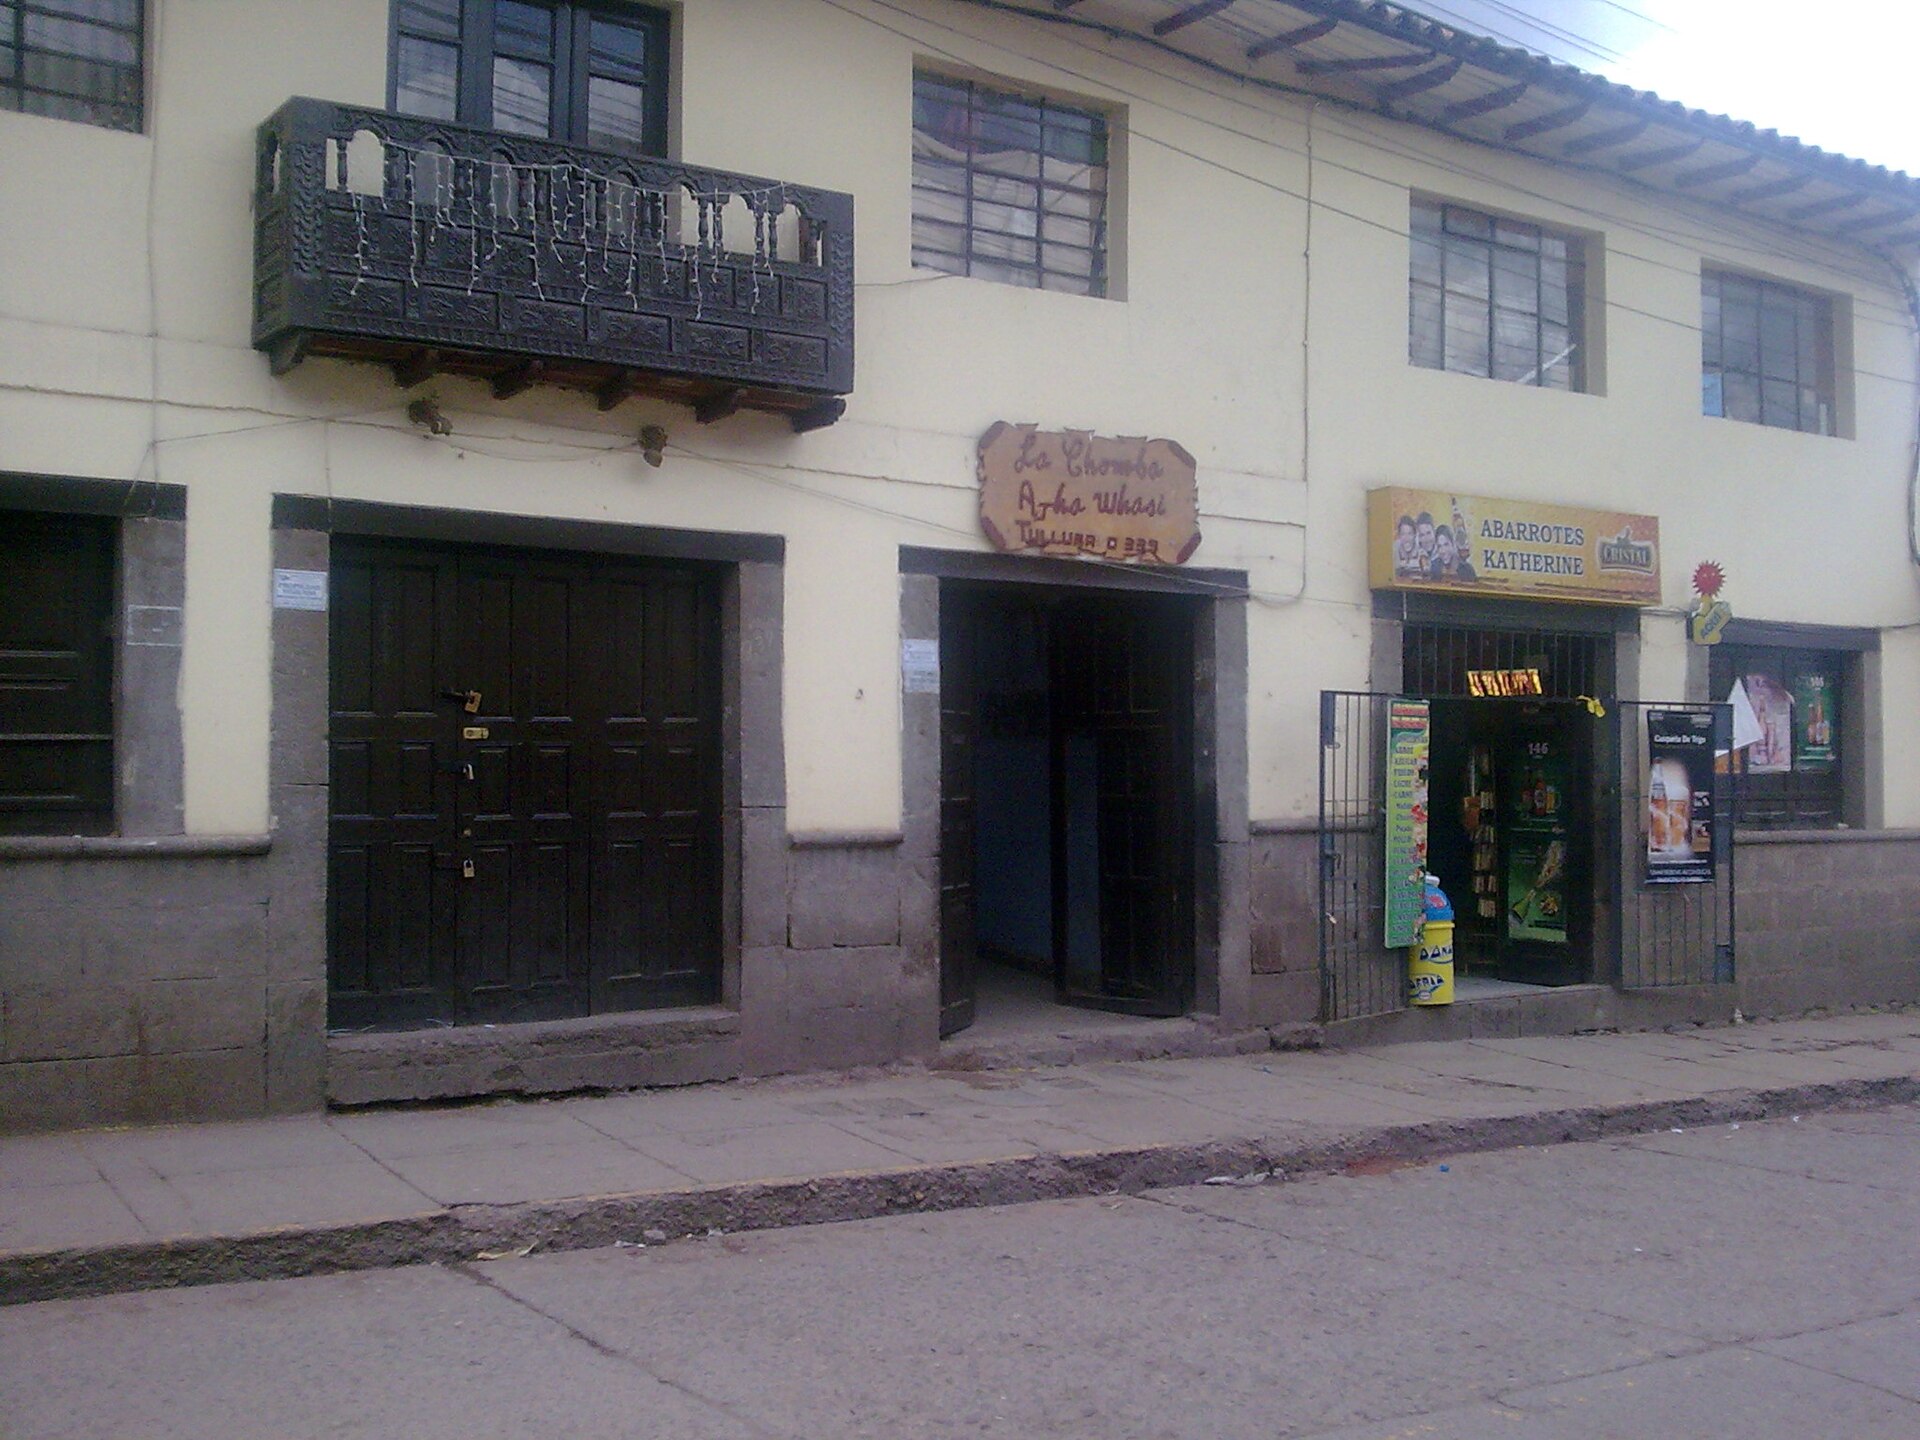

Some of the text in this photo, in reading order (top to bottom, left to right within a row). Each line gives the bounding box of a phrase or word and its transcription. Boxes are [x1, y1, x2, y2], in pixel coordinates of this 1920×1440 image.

[1015, 434, 1164, 480] La Chomba
[1481, 519, 1585, 546] ABARROTES
[1483, 550, 1584, 575] KATHERINE
[1603, 545, 1648, 564] CRISTAL
